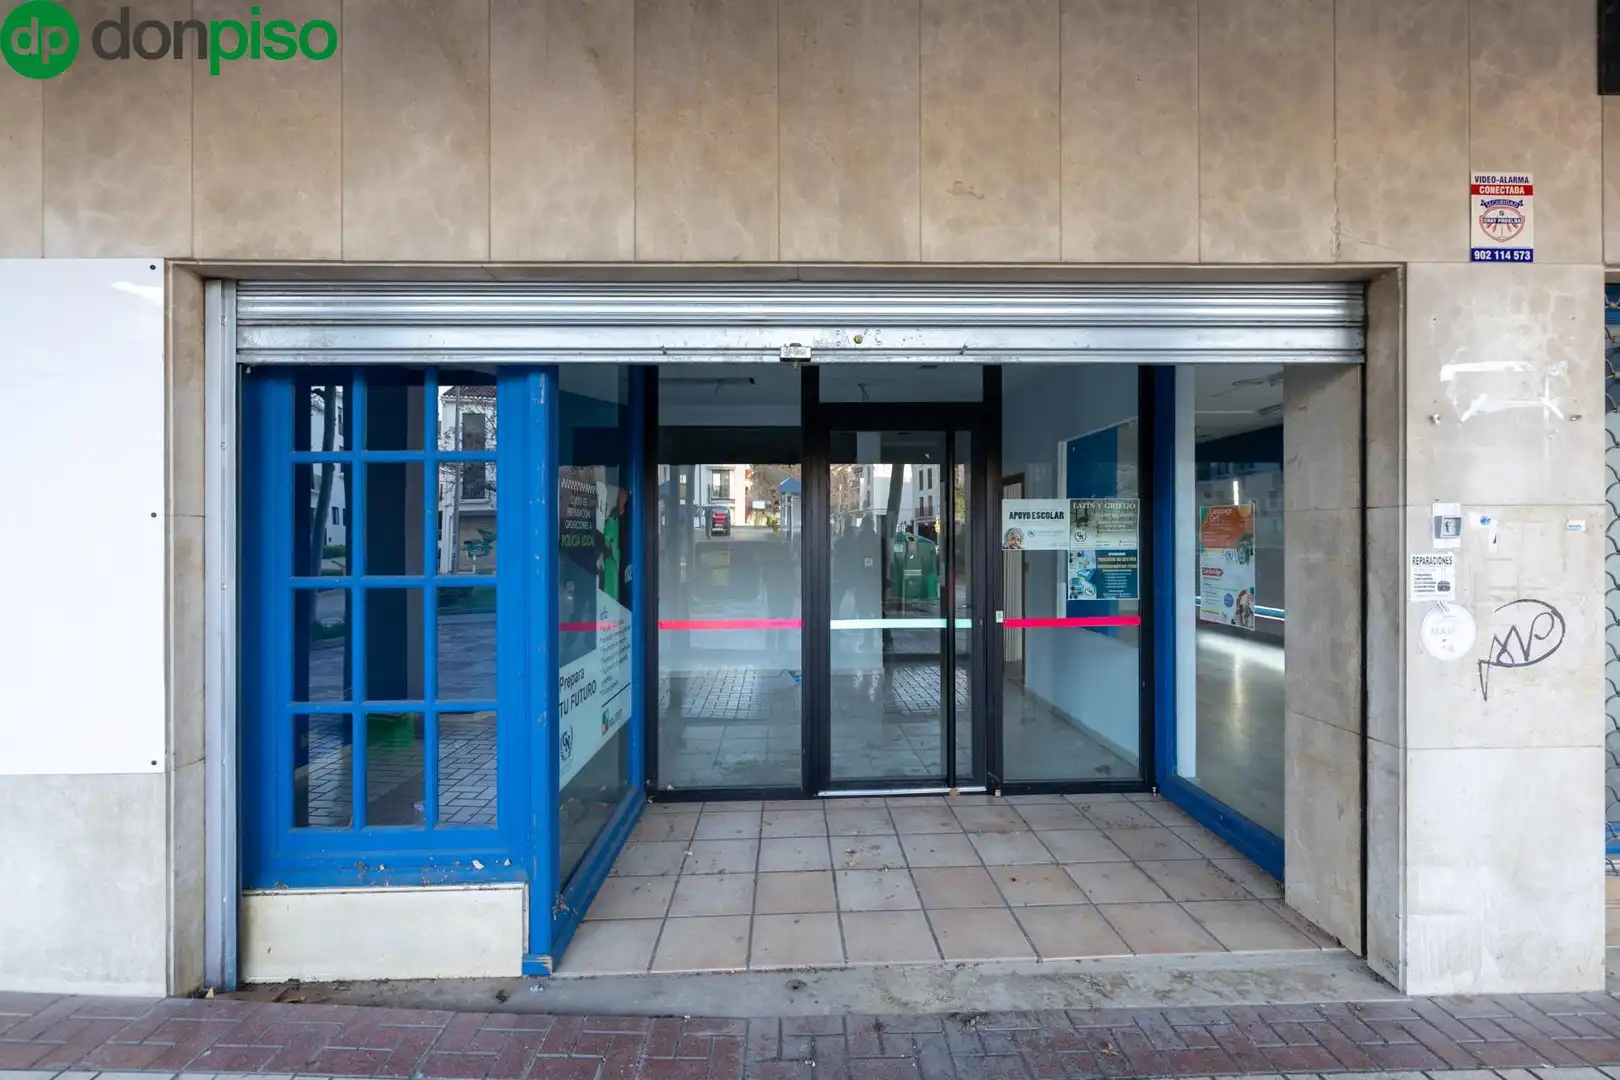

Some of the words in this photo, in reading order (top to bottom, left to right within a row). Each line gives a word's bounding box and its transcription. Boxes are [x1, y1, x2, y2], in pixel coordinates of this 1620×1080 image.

[1474, 175, 1529, 184] VIDEO-ALARMA
[1479, 186, 1525, 194] CONECTADA
[1474, 250, 1491, 260] 902
[1494, 250, 1511, 260] 114
[1513, 250, 1531, 260] 573
[1009, 511, 1031, 520] APOYO
[1031, 511, 1065, 520] ESCOLAR
[1411, 556, 1453, 566] REPARACIONES
[559, 668, 585, 692] Prepara
[559, 700, 569, 718] TU
[570, 679, 597, 708] FUTURO
